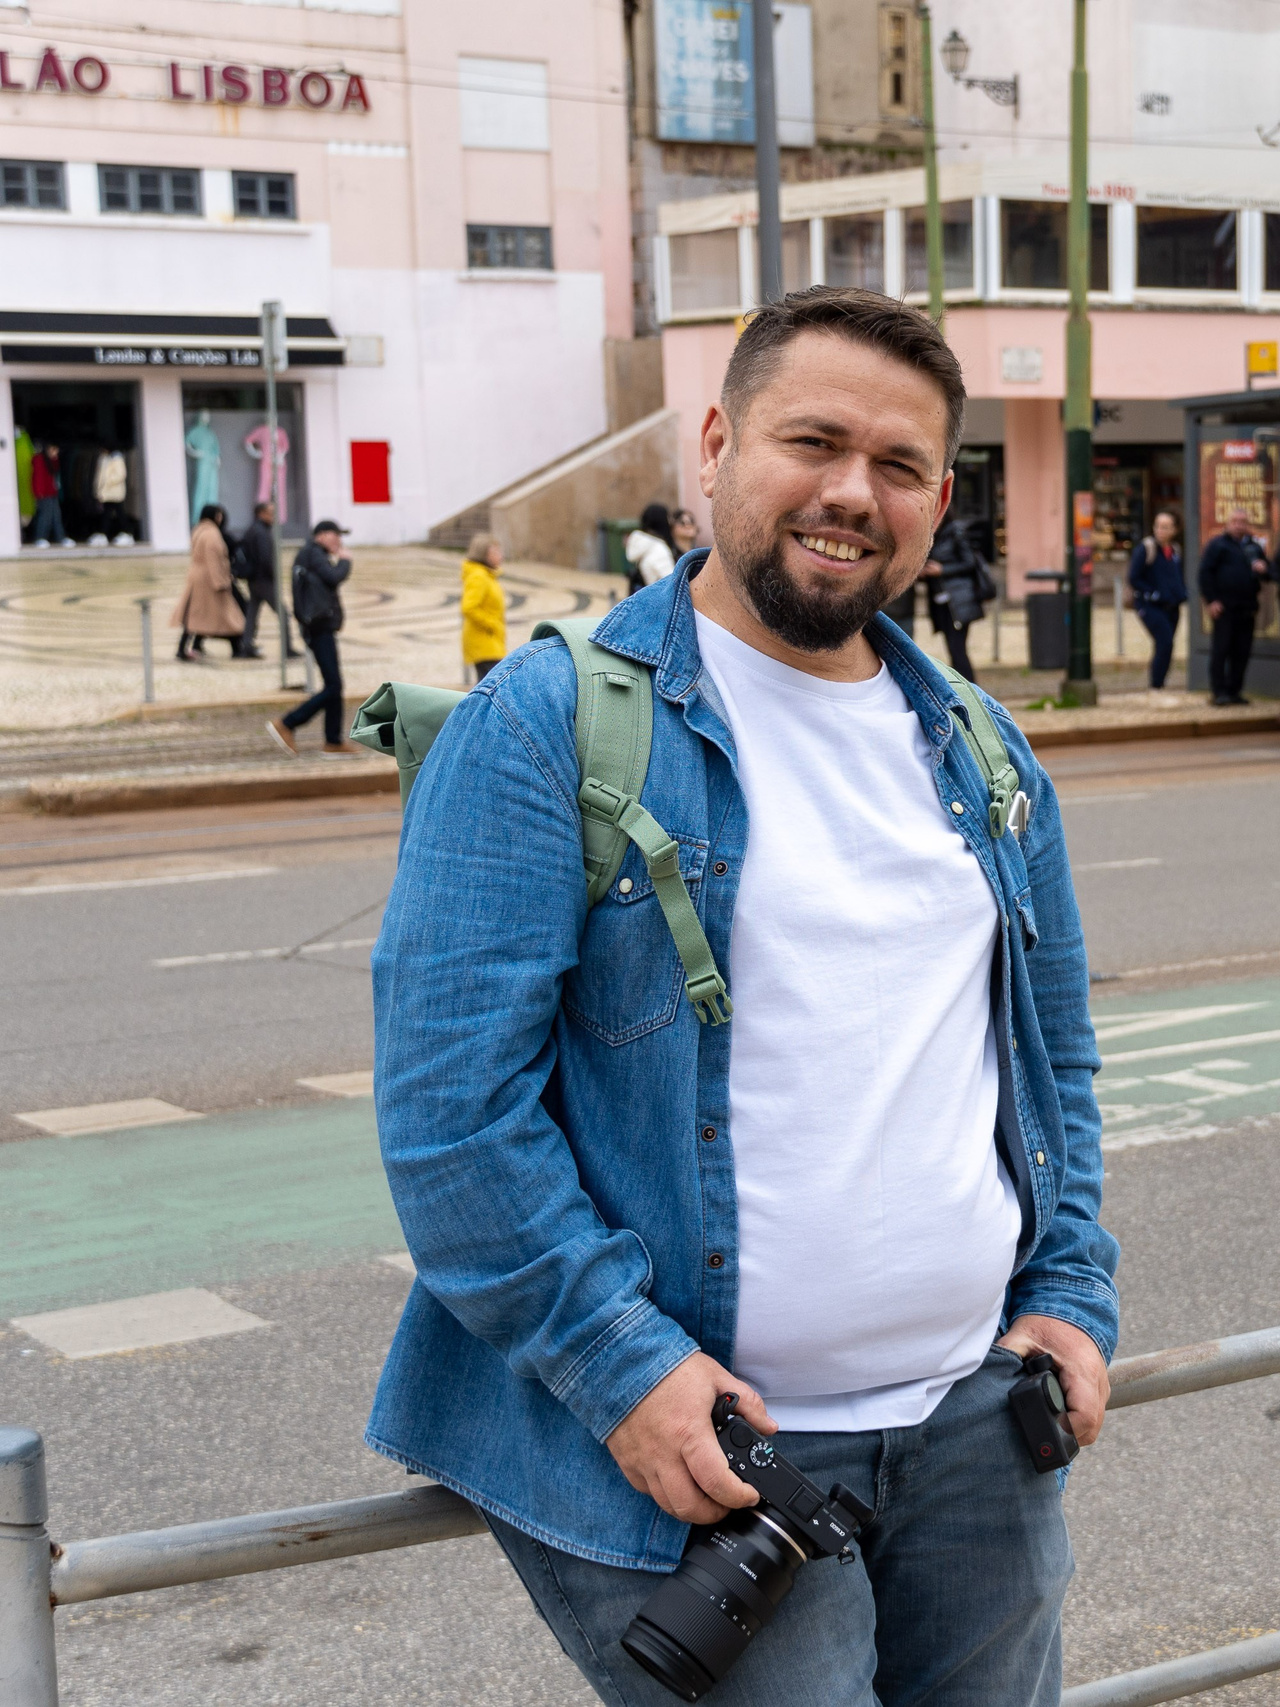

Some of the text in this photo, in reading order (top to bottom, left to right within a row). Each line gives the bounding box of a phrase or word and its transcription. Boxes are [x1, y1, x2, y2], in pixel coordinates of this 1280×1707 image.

[170, 62, 370, 112] LISBOA
[149, 347, 166, 365] &
[739, 1562, 758, 1580] TAMRON
